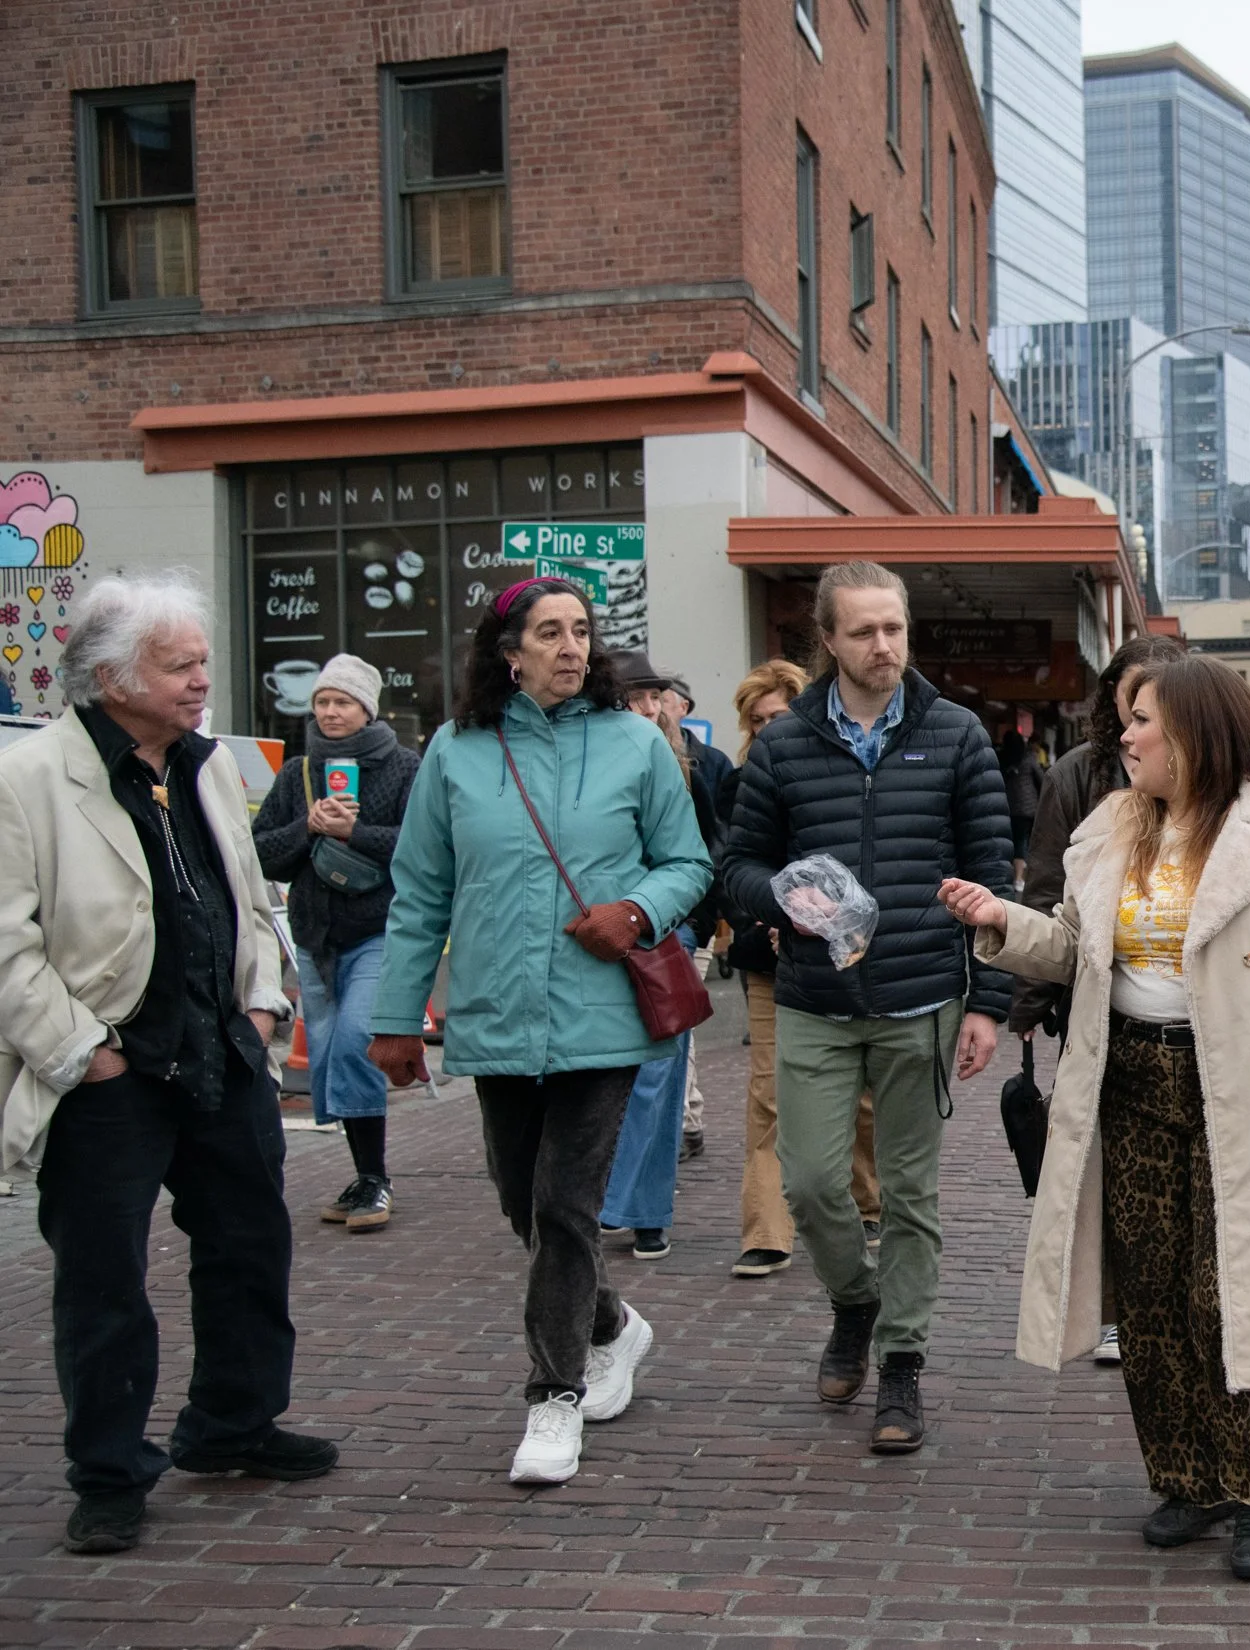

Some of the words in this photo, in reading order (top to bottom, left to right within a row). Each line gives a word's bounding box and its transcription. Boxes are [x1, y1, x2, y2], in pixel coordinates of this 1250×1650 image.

[274, 481, 469, 509] CINNAMON
[528, 470, 645, 493] WORKS
[537, 527, 586, 555] Pine
[597, 536, 615, 555] St
[617, 527, 643, 540] 1500
[269, 566, 317, 588] Fresh
[266, 596, 320, 620] Coffee
[382, 667, 414, 687] Tea
